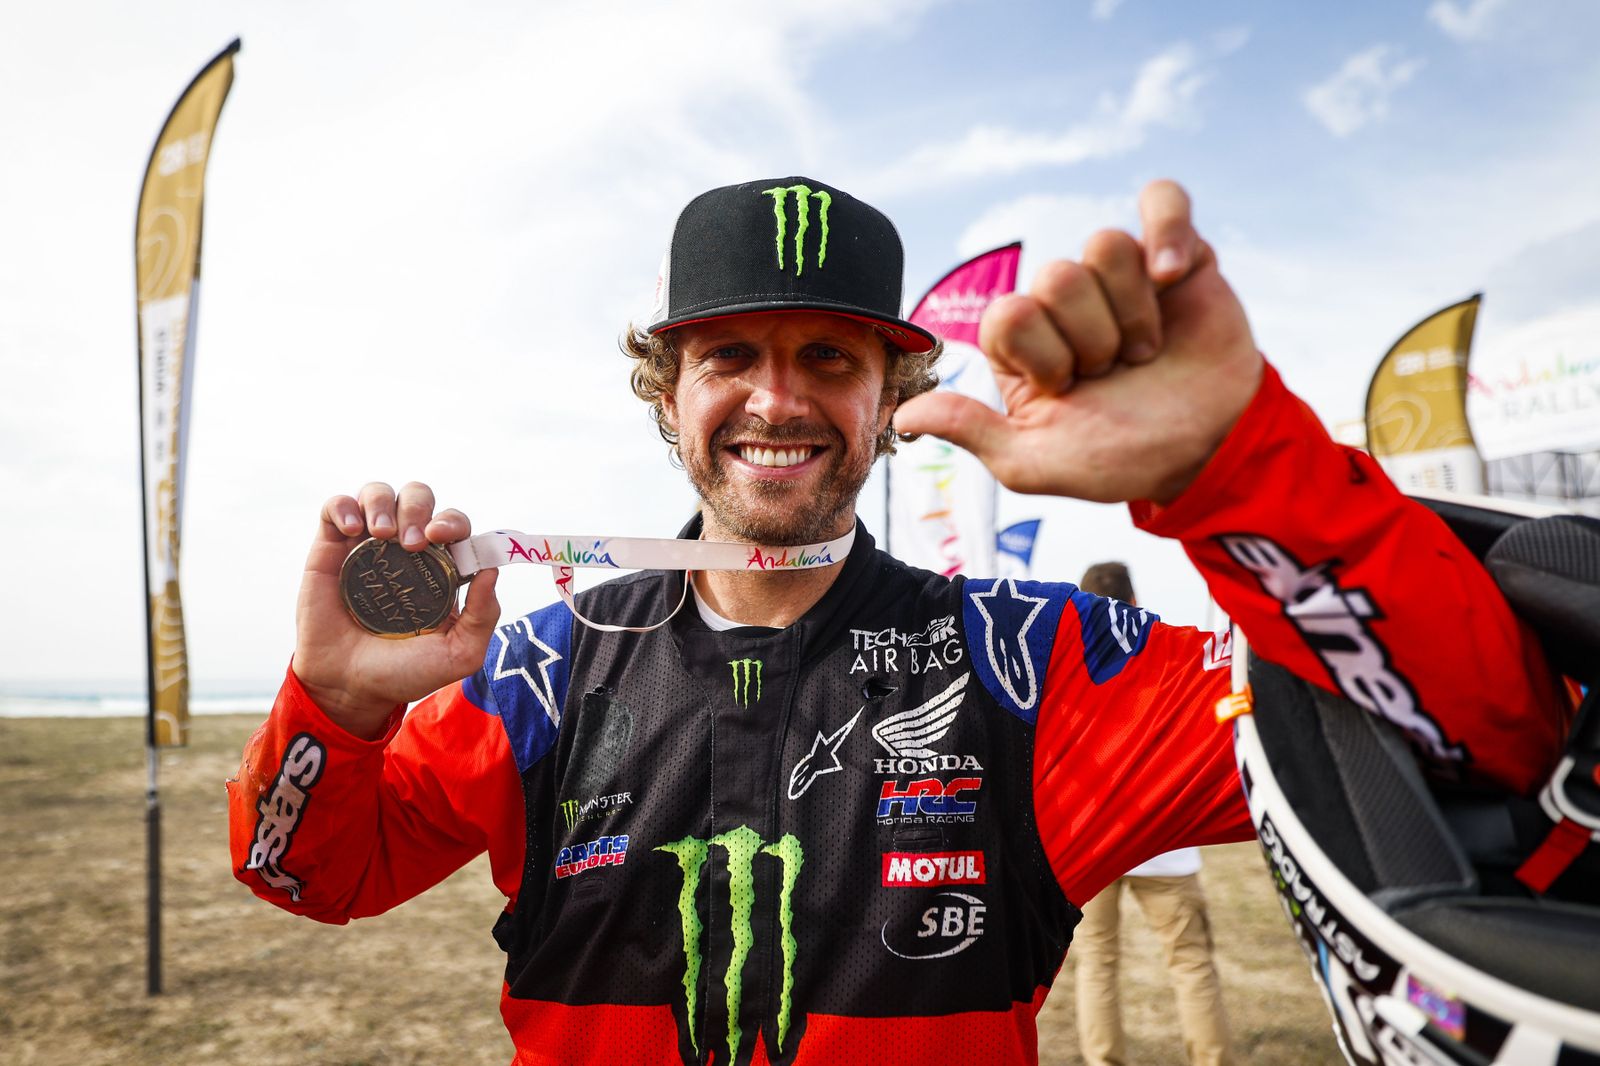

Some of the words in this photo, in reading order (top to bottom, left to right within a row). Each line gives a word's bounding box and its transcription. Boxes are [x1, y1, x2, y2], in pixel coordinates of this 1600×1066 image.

[506, 536, 620, 568] Andalucía
[747, 545, 834, 570] Andalucía
[410, 551, 444, 599] FINISHER
[358, 568, 405, 623] RALLY
[874, 754, 984, 774] HONDA
[876, 777, 983, 818] HRC
[926, 814, 976, 825] RACING
[887, 855, 981, 883] MOTUL
[917, 906, 987, 938] SBE
